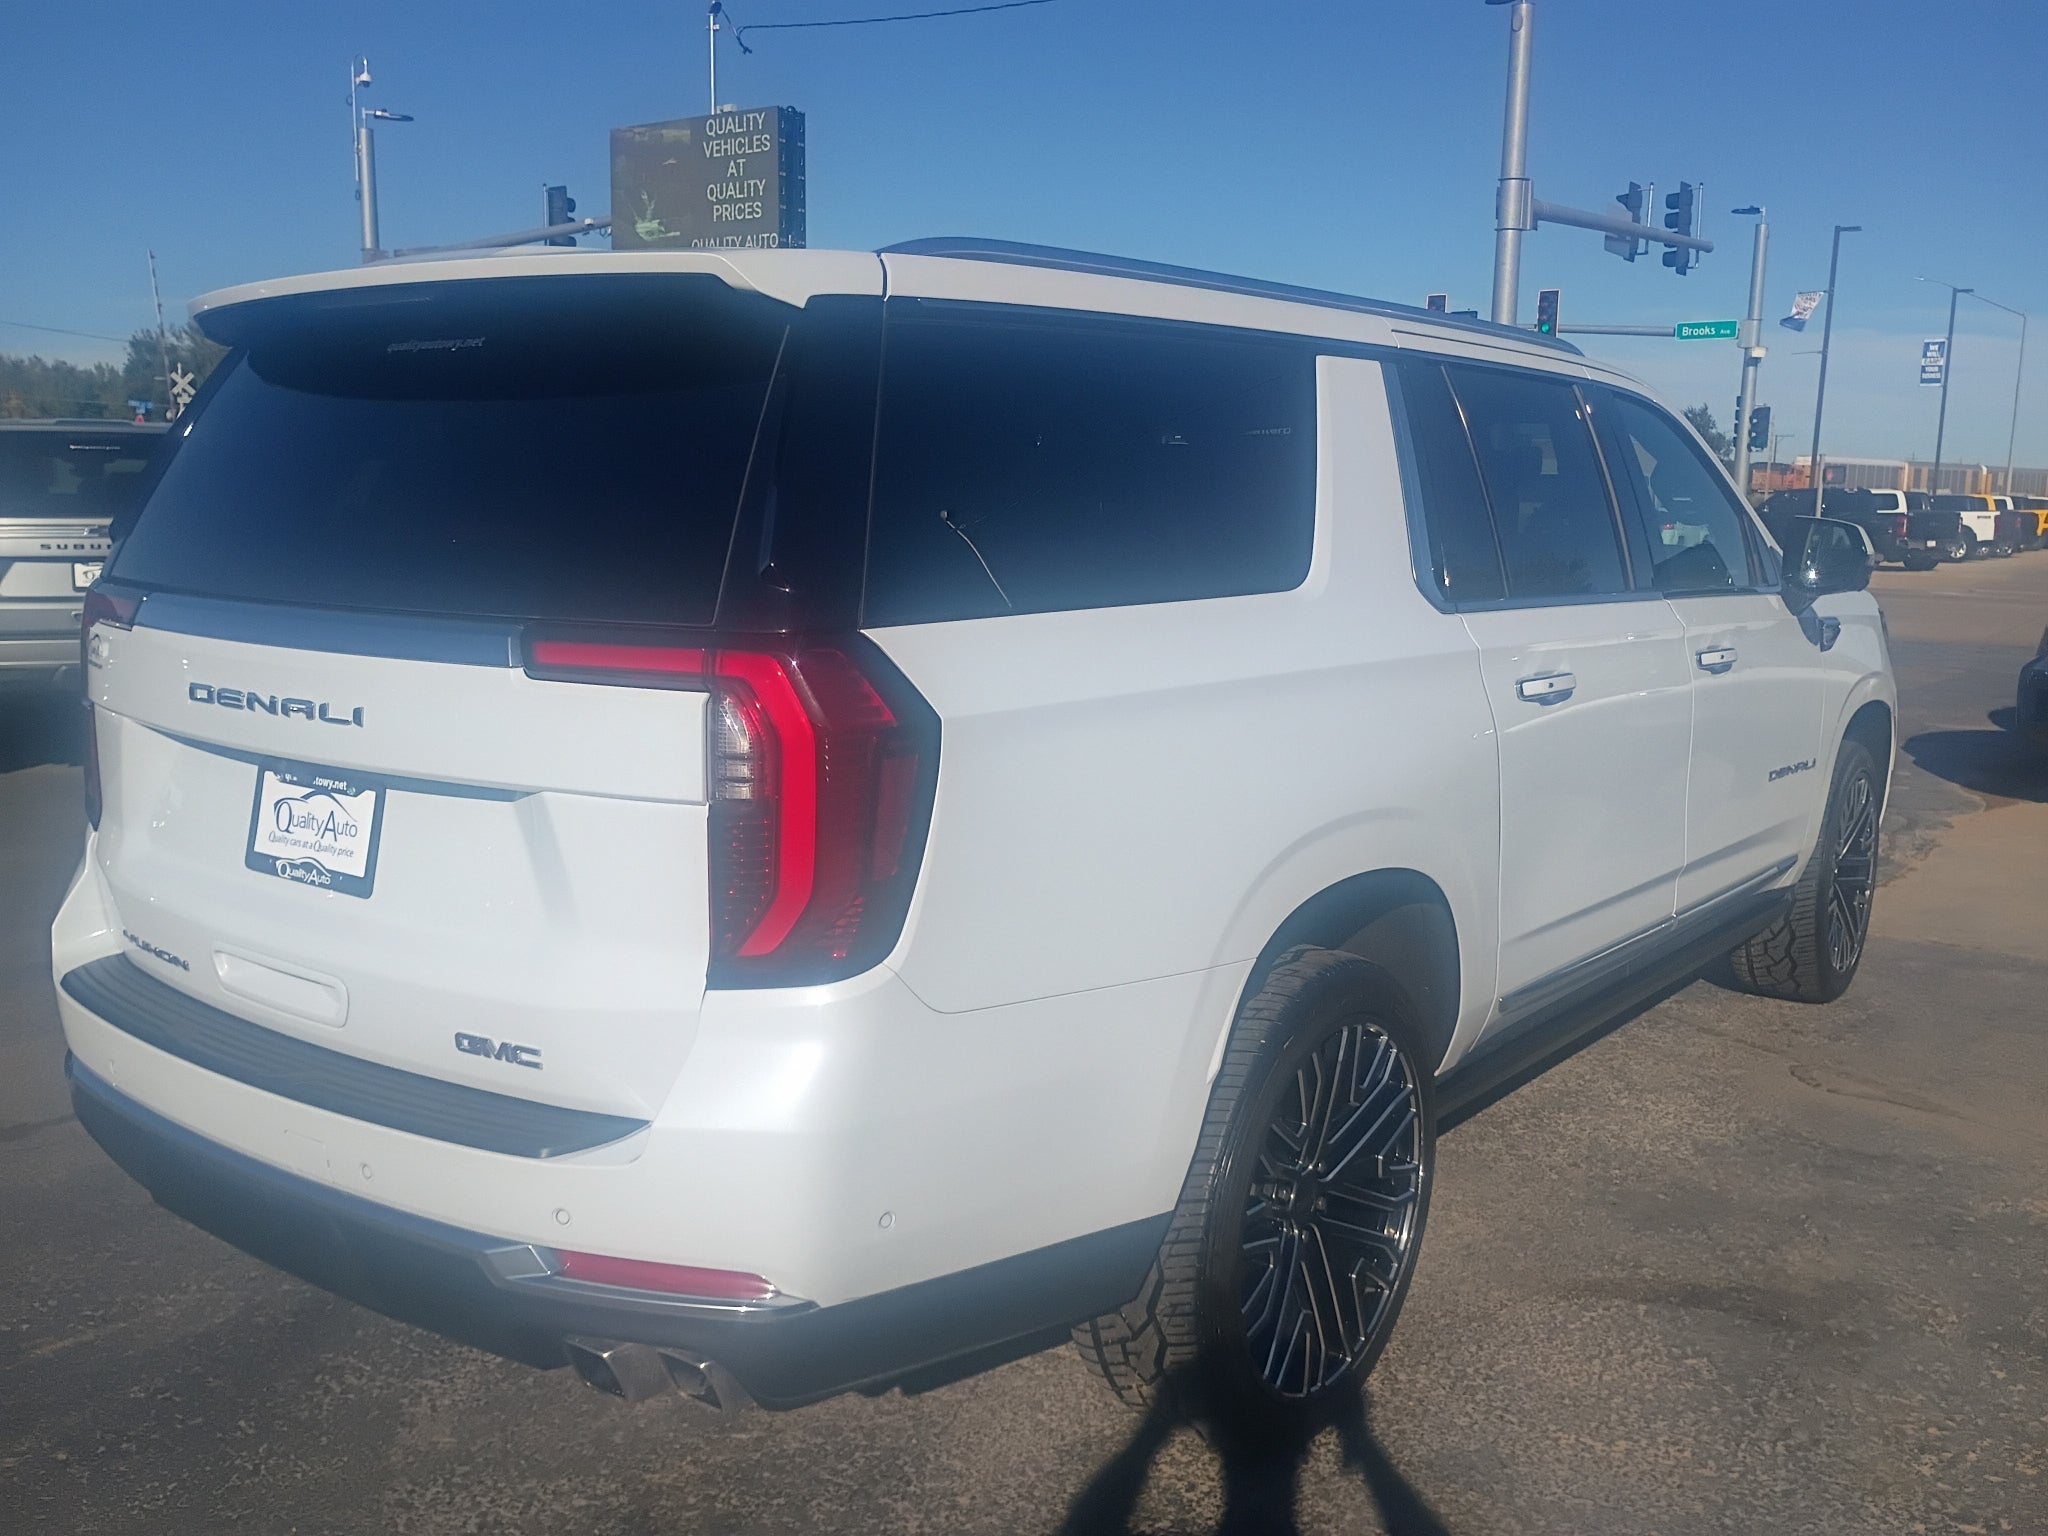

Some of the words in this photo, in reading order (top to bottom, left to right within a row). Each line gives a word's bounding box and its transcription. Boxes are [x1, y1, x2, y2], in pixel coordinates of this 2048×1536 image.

[706, 112, 766, 137] QUALITY
[703, 134, 771, 158] VEHICLES
[727, 159, 746, 177] AT
[706, 179, 766, 202] QUALITY
[713, 202, 762, 222] PRICES
[745, 233, 778, 248] AUTO
[1682, 326, 1716, 336] Brooks
[189, 682, 365, 728] DENALI
[1768, 757, 1816, 782] DENALI
[269, 831, 290, 847] Quality
[290, 838, 302, 849] cars
[313, 840, 338, 856] Quality
[337, 847, 354, 857] price
[455, 1031, 544, 1070] GMC
